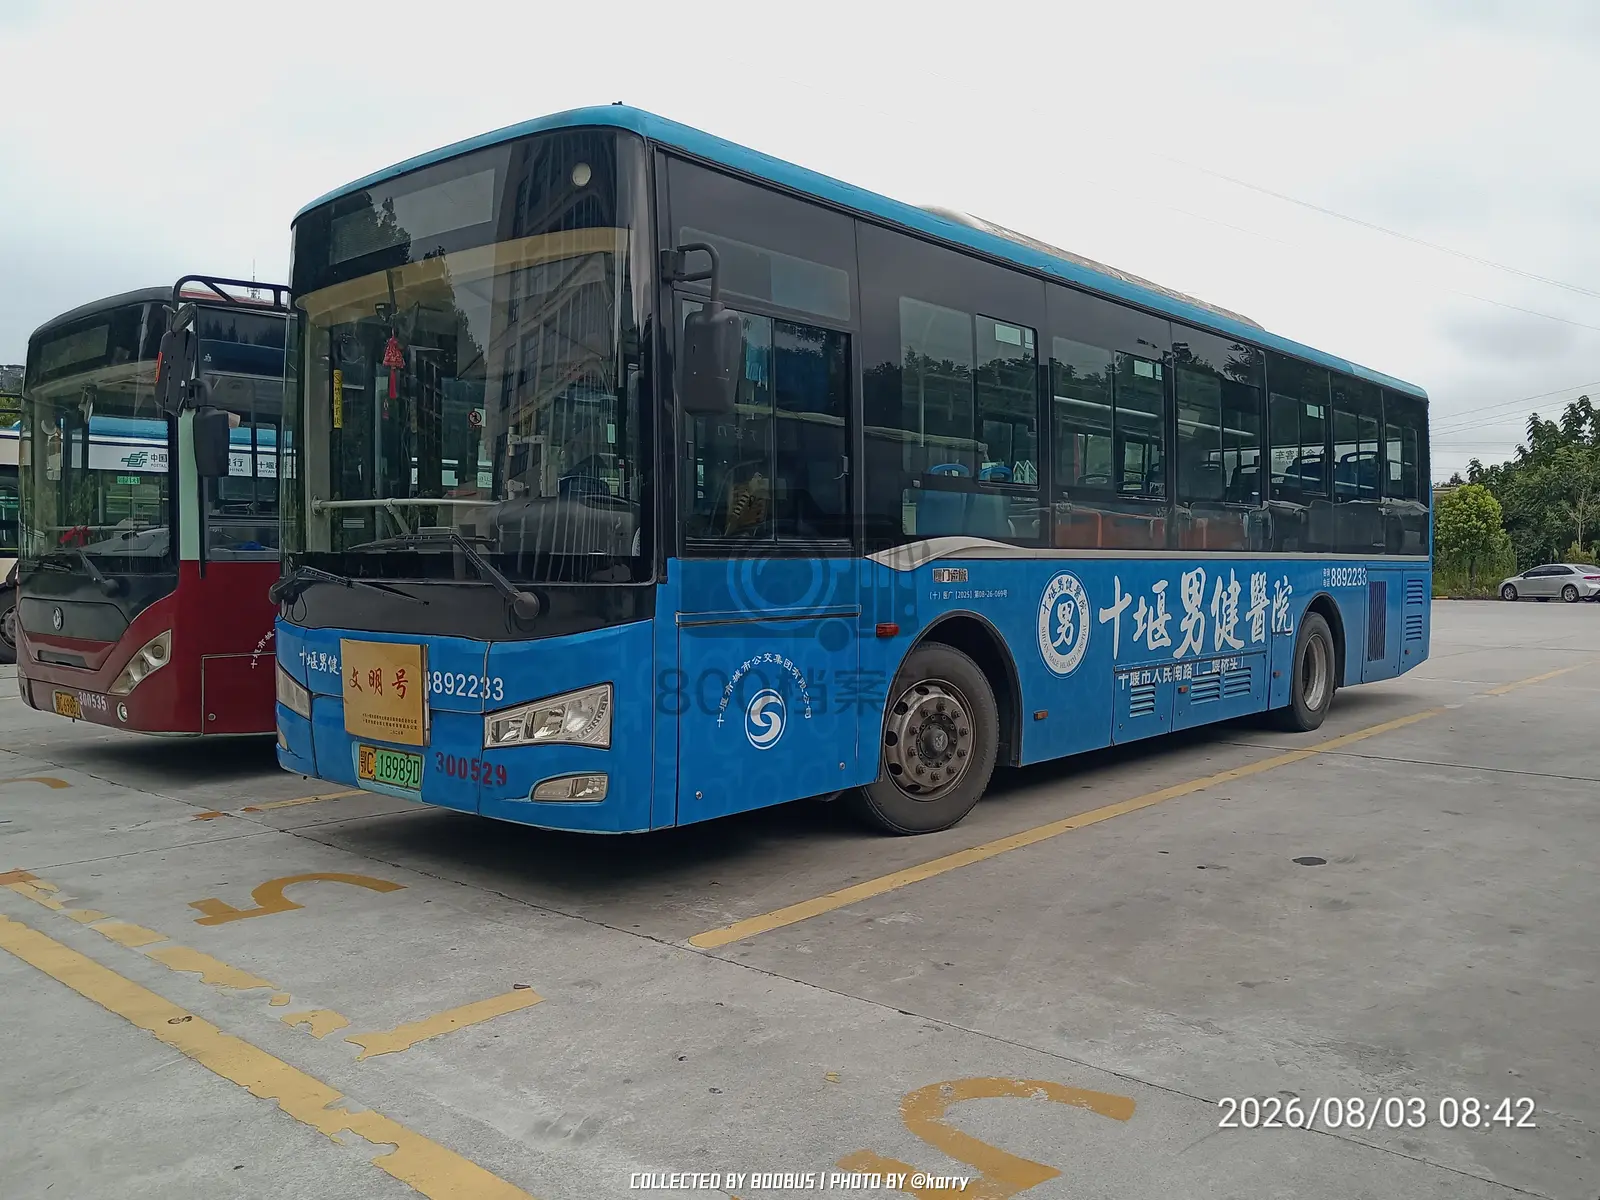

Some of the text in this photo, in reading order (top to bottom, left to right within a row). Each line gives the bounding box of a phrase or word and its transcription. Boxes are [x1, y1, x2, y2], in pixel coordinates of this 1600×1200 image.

[1330, 567, 1368, 588] 8892233
[298, 645, 343, 676] 十堰男健
[349, 666, 409, 700] 文明号
[78, 691, 107, 712] 300535
[435, 751, 508, 786] 300529
